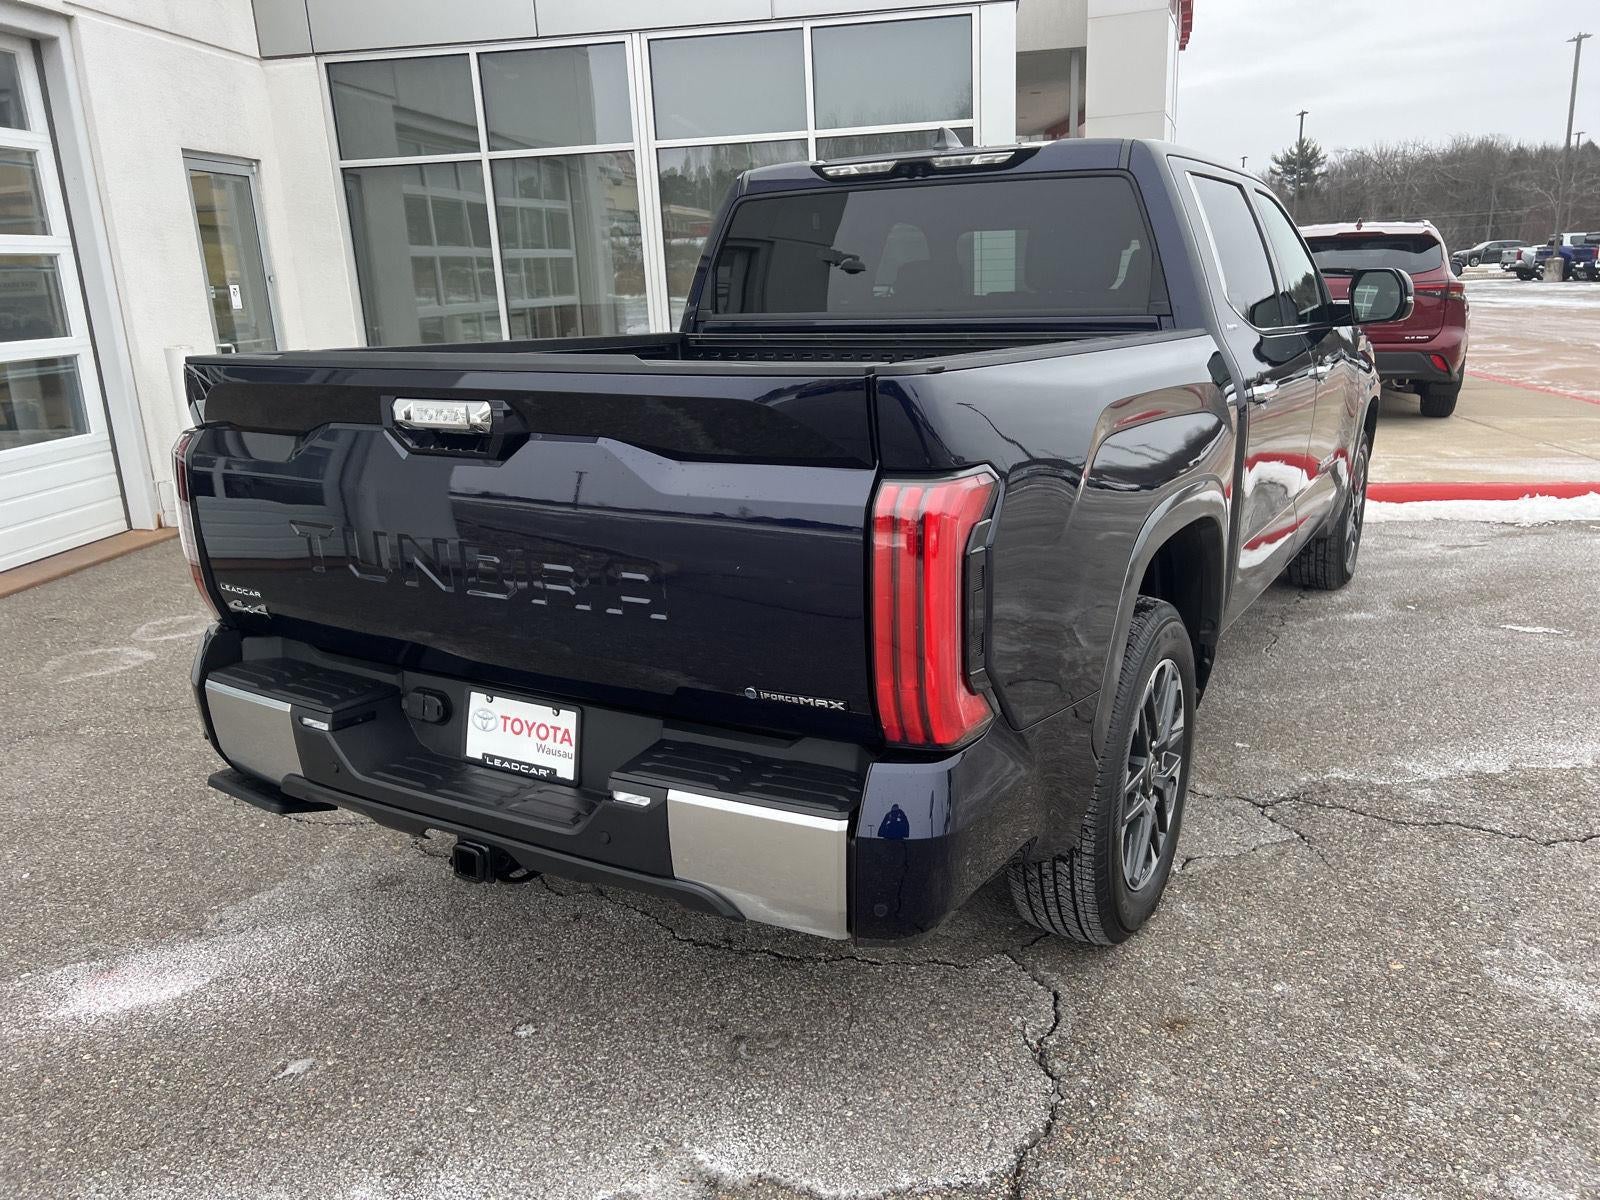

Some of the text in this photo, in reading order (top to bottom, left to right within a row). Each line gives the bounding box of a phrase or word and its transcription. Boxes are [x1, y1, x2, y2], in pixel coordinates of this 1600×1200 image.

[416, 407, 466, 422] TOYOTA
[289, 519, 670, 621] TUNDRA
[220, 583, 262, 598] LEADCAR
[500, 714, 573, 747] TOYOTA
[536, 742, 573, 760] Wausau
[486, 757, 548, 777] LEADCAR
